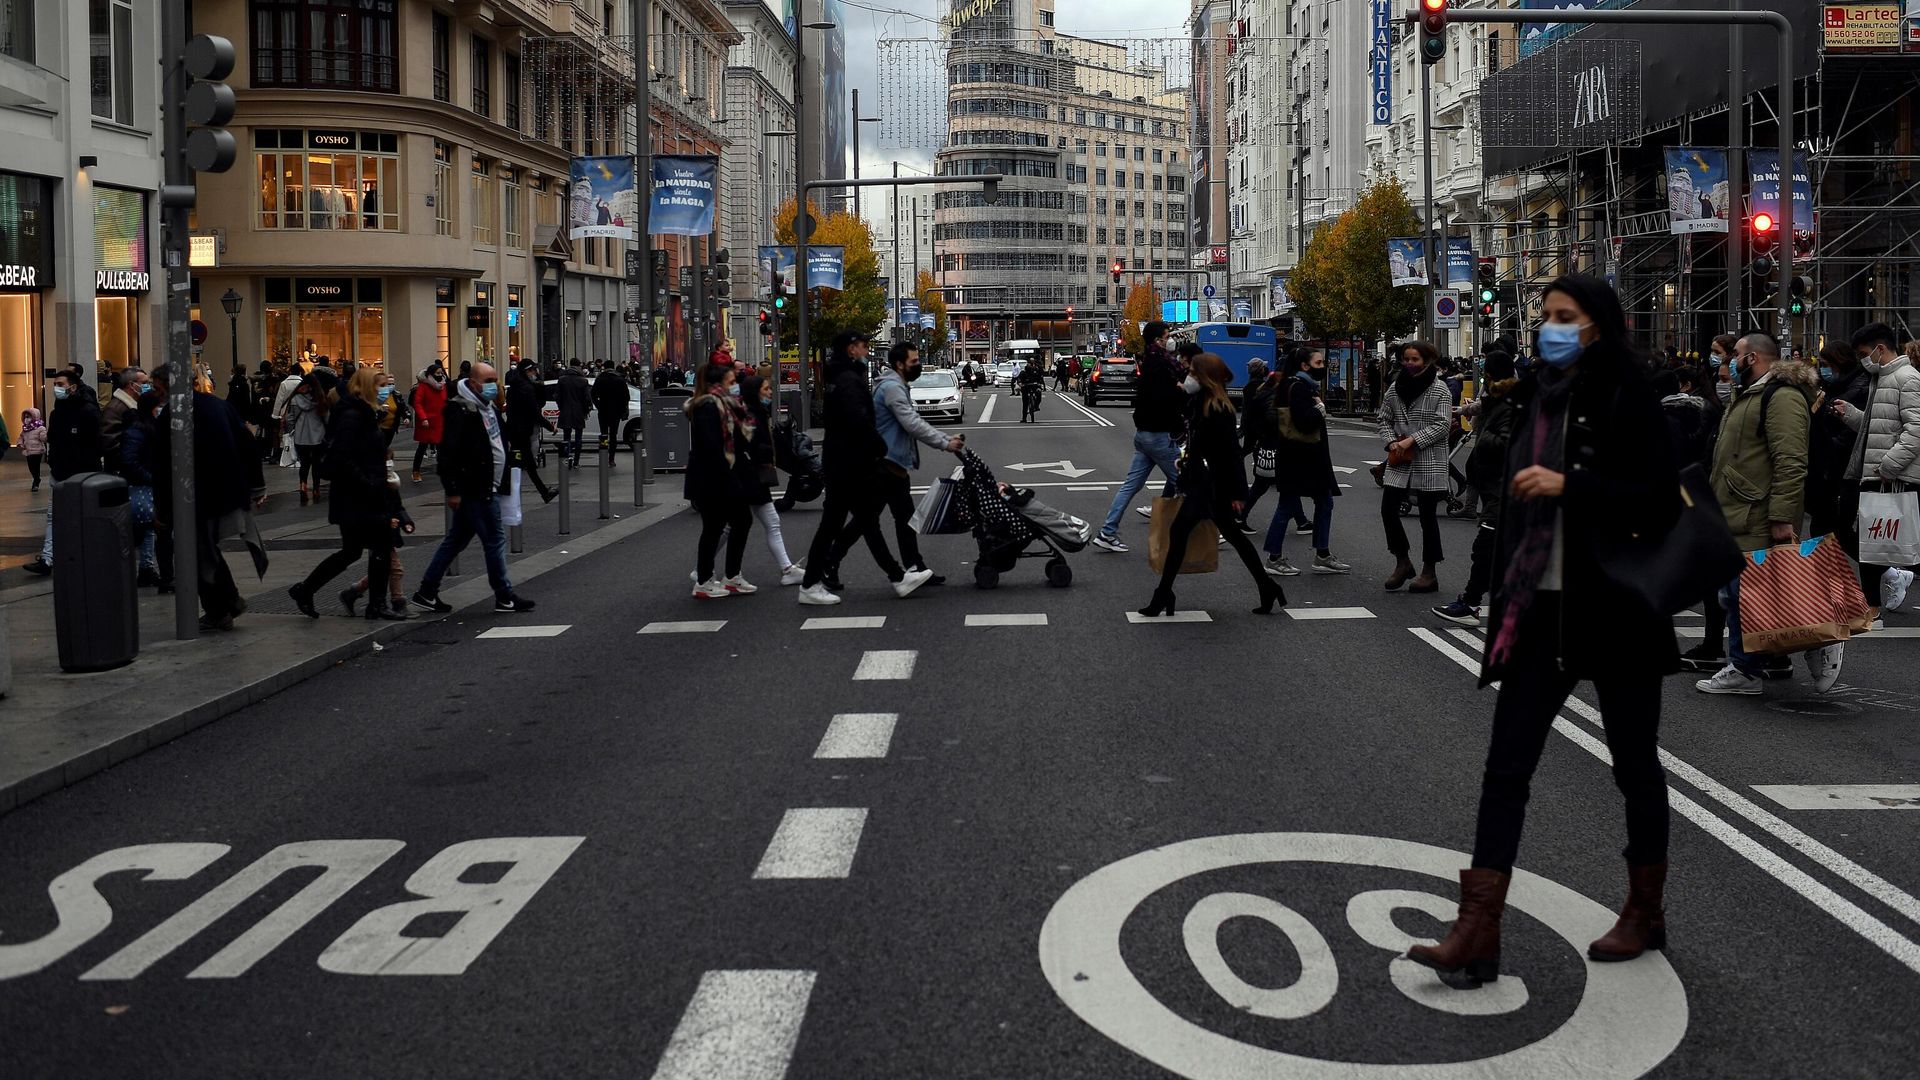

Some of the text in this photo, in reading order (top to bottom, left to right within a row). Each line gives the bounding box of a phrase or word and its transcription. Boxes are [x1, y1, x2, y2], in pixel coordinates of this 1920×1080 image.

[1846, 8, 1899, 21] Lartec
[1825, 30, 1875, 38] 91 560 52 06
[1573, 61, 1612, 129] ZARA
[315, 135, 349, 145] OYSHO
[674, 169, 694, 178] Vuelve
[1753, 173, 1764, 182] la
[655, 179, 713, 191] la NAVIDAD,
[673, 187, 692, 196] siente
[1762, 191, 1772, 200] la
[660, 197, 705, 208] la MAGIA
[97, 270, 149, 290] PULL&BEAR
[307, 286, 341, 295] OYSHO
[1867, 517, 1900, 541] H&M
[1758, 628, 1818, 644] PRIMARK
[0, 836, 586, 980] BUS
[1182, 888, 1530, 1020] 30
